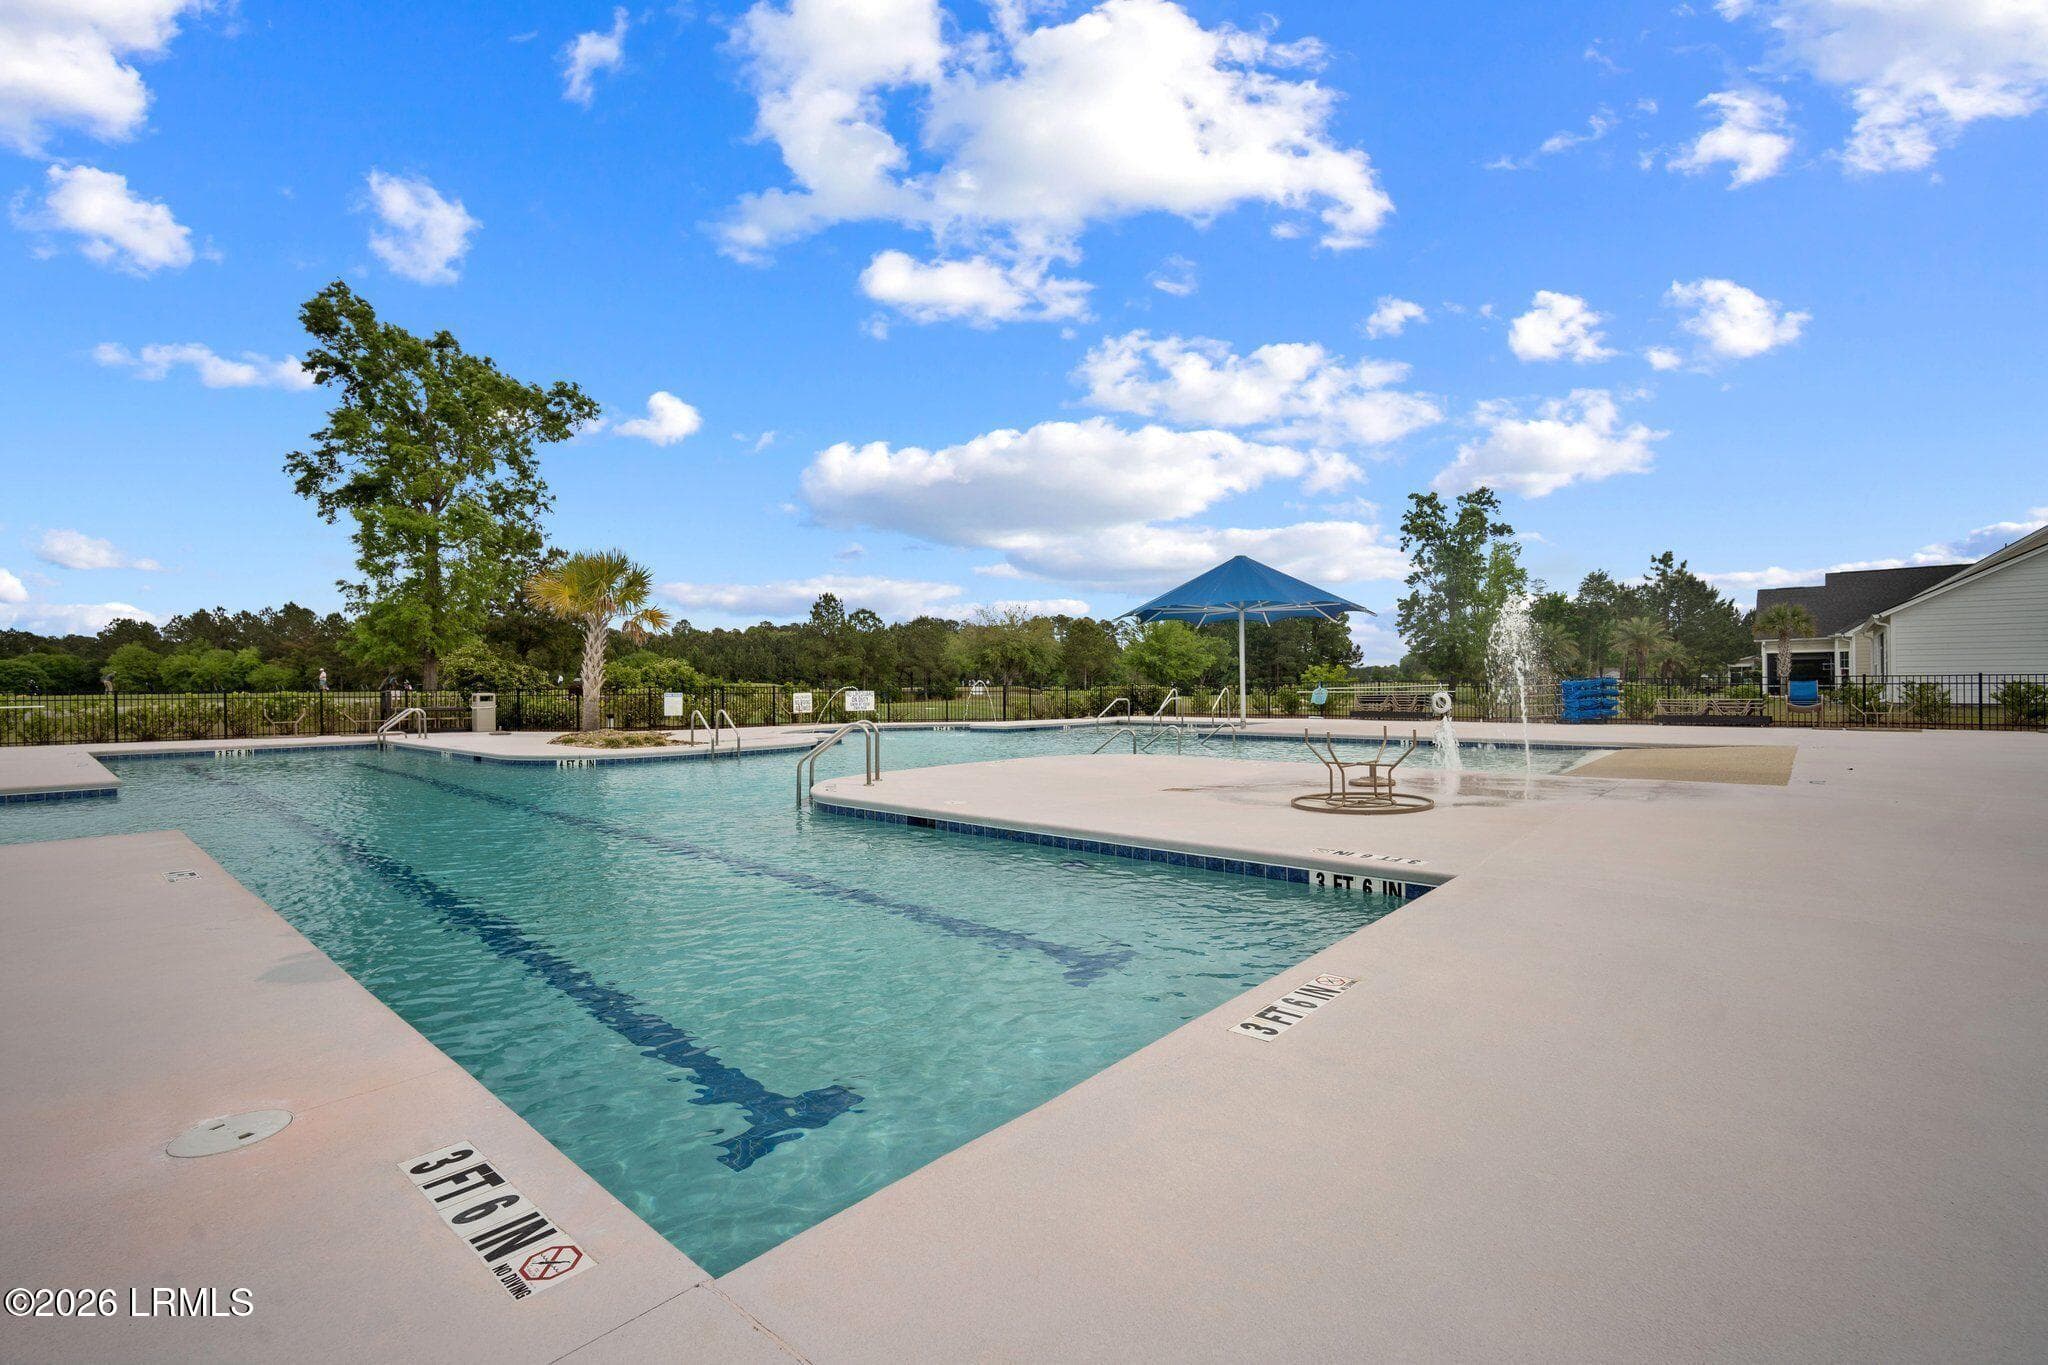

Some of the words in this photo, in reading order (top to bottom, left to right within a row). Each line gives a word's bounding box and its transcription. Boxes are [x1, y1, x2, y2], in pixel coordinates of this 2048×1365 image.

[1315, 871, 1325, 887] 3
[1333, 874, 1354, 890] FT
[1362, 878, 1373, 894] 6
[1382, 880, 1403, 898] IN
[1281, 997, 1318, 1009] 6
[1294, 984, 1342, 1001] IN
[1254, 1005, 1304, 1026] FT
[1239, 1022, 1279, 1036] 3
[409, 1149, 474, 1175] 3
[422, 1163, 506, 1203] FT
[451, 1194, 521, 1225] 6
[468, 1211, 558, 1263] IN
[492, 1263, 513, 1277] NO
[500, 1272, 532, 1300] DIVING
